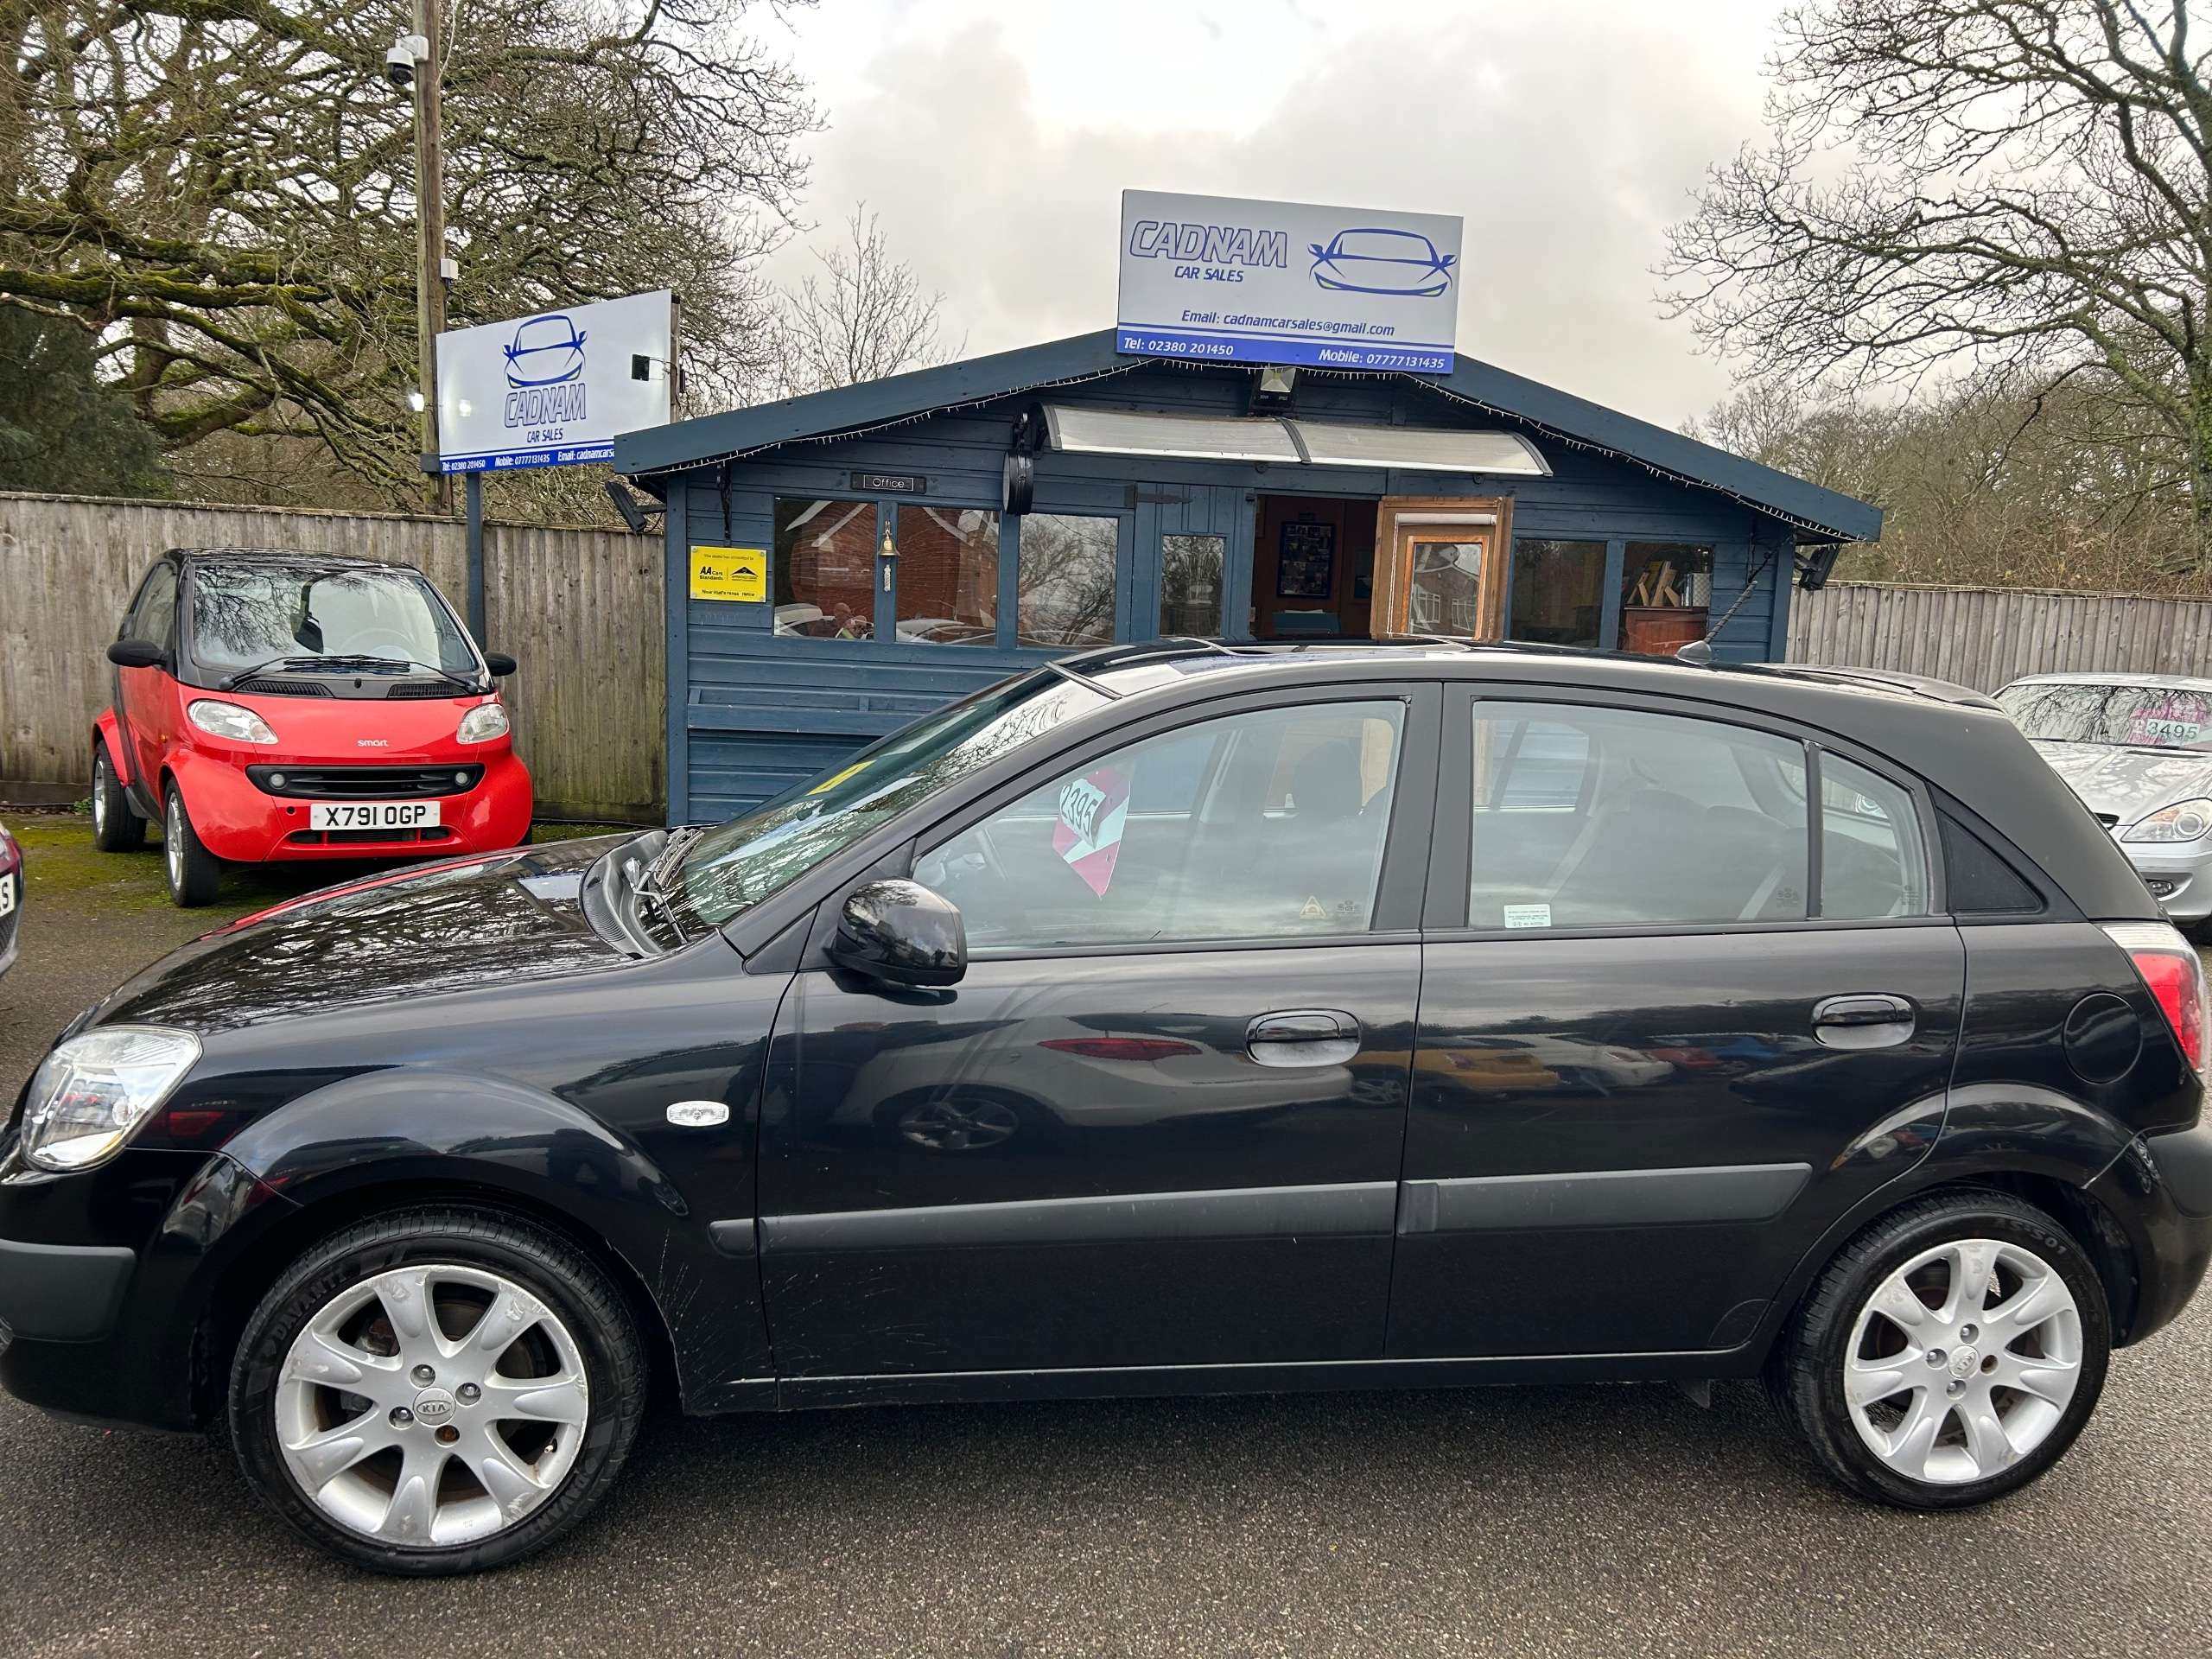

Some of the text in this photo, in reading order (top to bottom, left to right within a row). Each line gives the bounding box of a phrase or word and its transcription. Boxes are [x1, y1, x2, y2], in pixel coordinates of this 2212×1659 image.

[1129, 220, 1287, 268] CADNAM
[1174, 266, 1244, 283] CAR SALES
[1181, 310, 1395, 336] Email: cadnamcarsales@gmail.com
[1123, 337, 1234, 355] Tel: 02380 201450
[1319, 350, 1445, 369] Mobile: 07777131435
[504, 383, 587, 428] CADNAM
[527, 428, 563, 442] CAR SALES
[495, 456, 514, 467] Mobile:
[557, 450, 576, 461] Email:
[872, 478, 905, 488] Office
[699, 566, 712, 575] AA
[2146, 721, 2198, 741] 3495
[325, 805, 427, 827] X791 OGP
